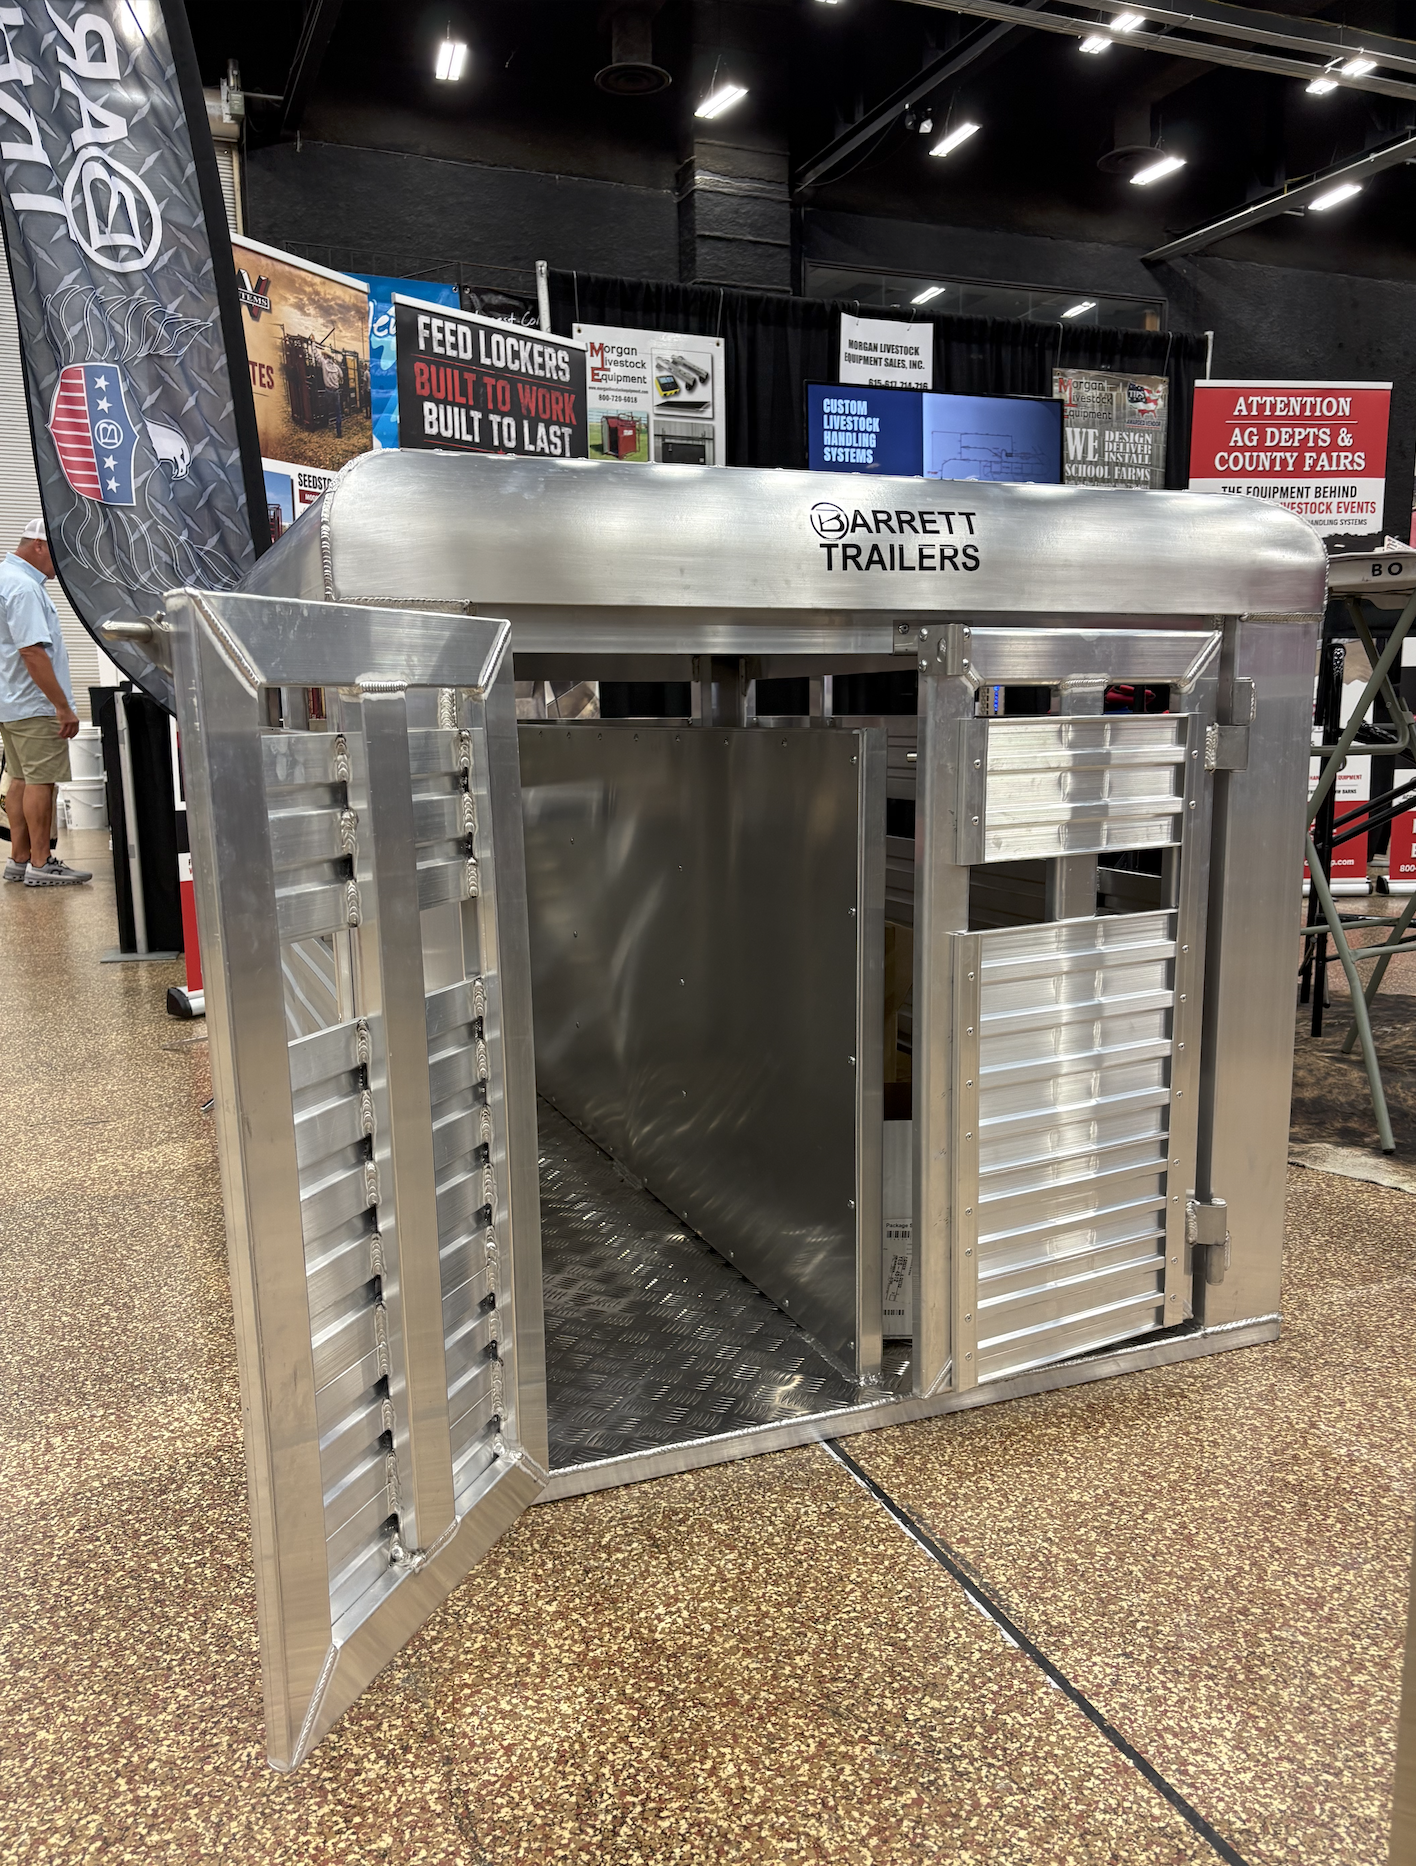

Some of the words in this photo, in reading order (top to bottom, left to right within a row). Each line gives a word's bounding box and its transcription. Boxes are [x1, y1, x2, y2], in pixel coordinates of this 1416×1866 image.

[417, 314, 473, 360] FEED
[479, 330, 570, 382] LOCKERS
[589, 342, 638, 357] Morgan
[848, 339, 878, 352] MORGAN
[880, 343, 920, 356] LIVESTOCK
[600, 354, 647, 371] Livestock
[844, 352, 883, 366] EQUIPMENT
[884, 357, 908, 370] SALES,
[909, 359, 925, 370] INC.
[591, 367, 648, 384] Equipment
[414, 362, 476, 406] BUILT
[483, 376, 511, 412] TO
[517, 383, 577, 425] WORK
[1058, 378, 1104, 393] Morgan
[1128, 390, 1144, 399] TIPS
[823, 398, 868, 415] CUSTOM
[1233, 396, 1352, 416] ATTENTION
[423, 401, 482, 443] BUILT
[488, 413, 517, 448] TO
[523, 420, 572, 457] LAST
[823, 414, 880, 432] LIVESTOCK
[823, 430, 877, 448] HANDLING
[1065, 427, 1099, 461] WE
[1104, 430, 1152, 444] DESIGN
[1229, 427, 1259, 447] AG
[1264, 427, 1331, 447] DEPTS
[1337, 427, 1353, 447] &
[823, 447, 874, 464] SYSTEMS
[1104, 441, 1152, 455] DELIVER
[1104, 452, 1151, 465] INSTALL
[1214, 451, 1298, 471] COUNTY
[1303, 452, 1366, 471] FAIRS
[1065, 463, 1110, 479] SCHOOL
[1114, 466, 1151, 481] FARMS
[1314, 485, 1357, 499] BEHIND
[1336, 501, 1376, 514] EVENTS
[812, 505, 976, 538] BARRETT
[819, 543, 980, 572] TRAILERS
